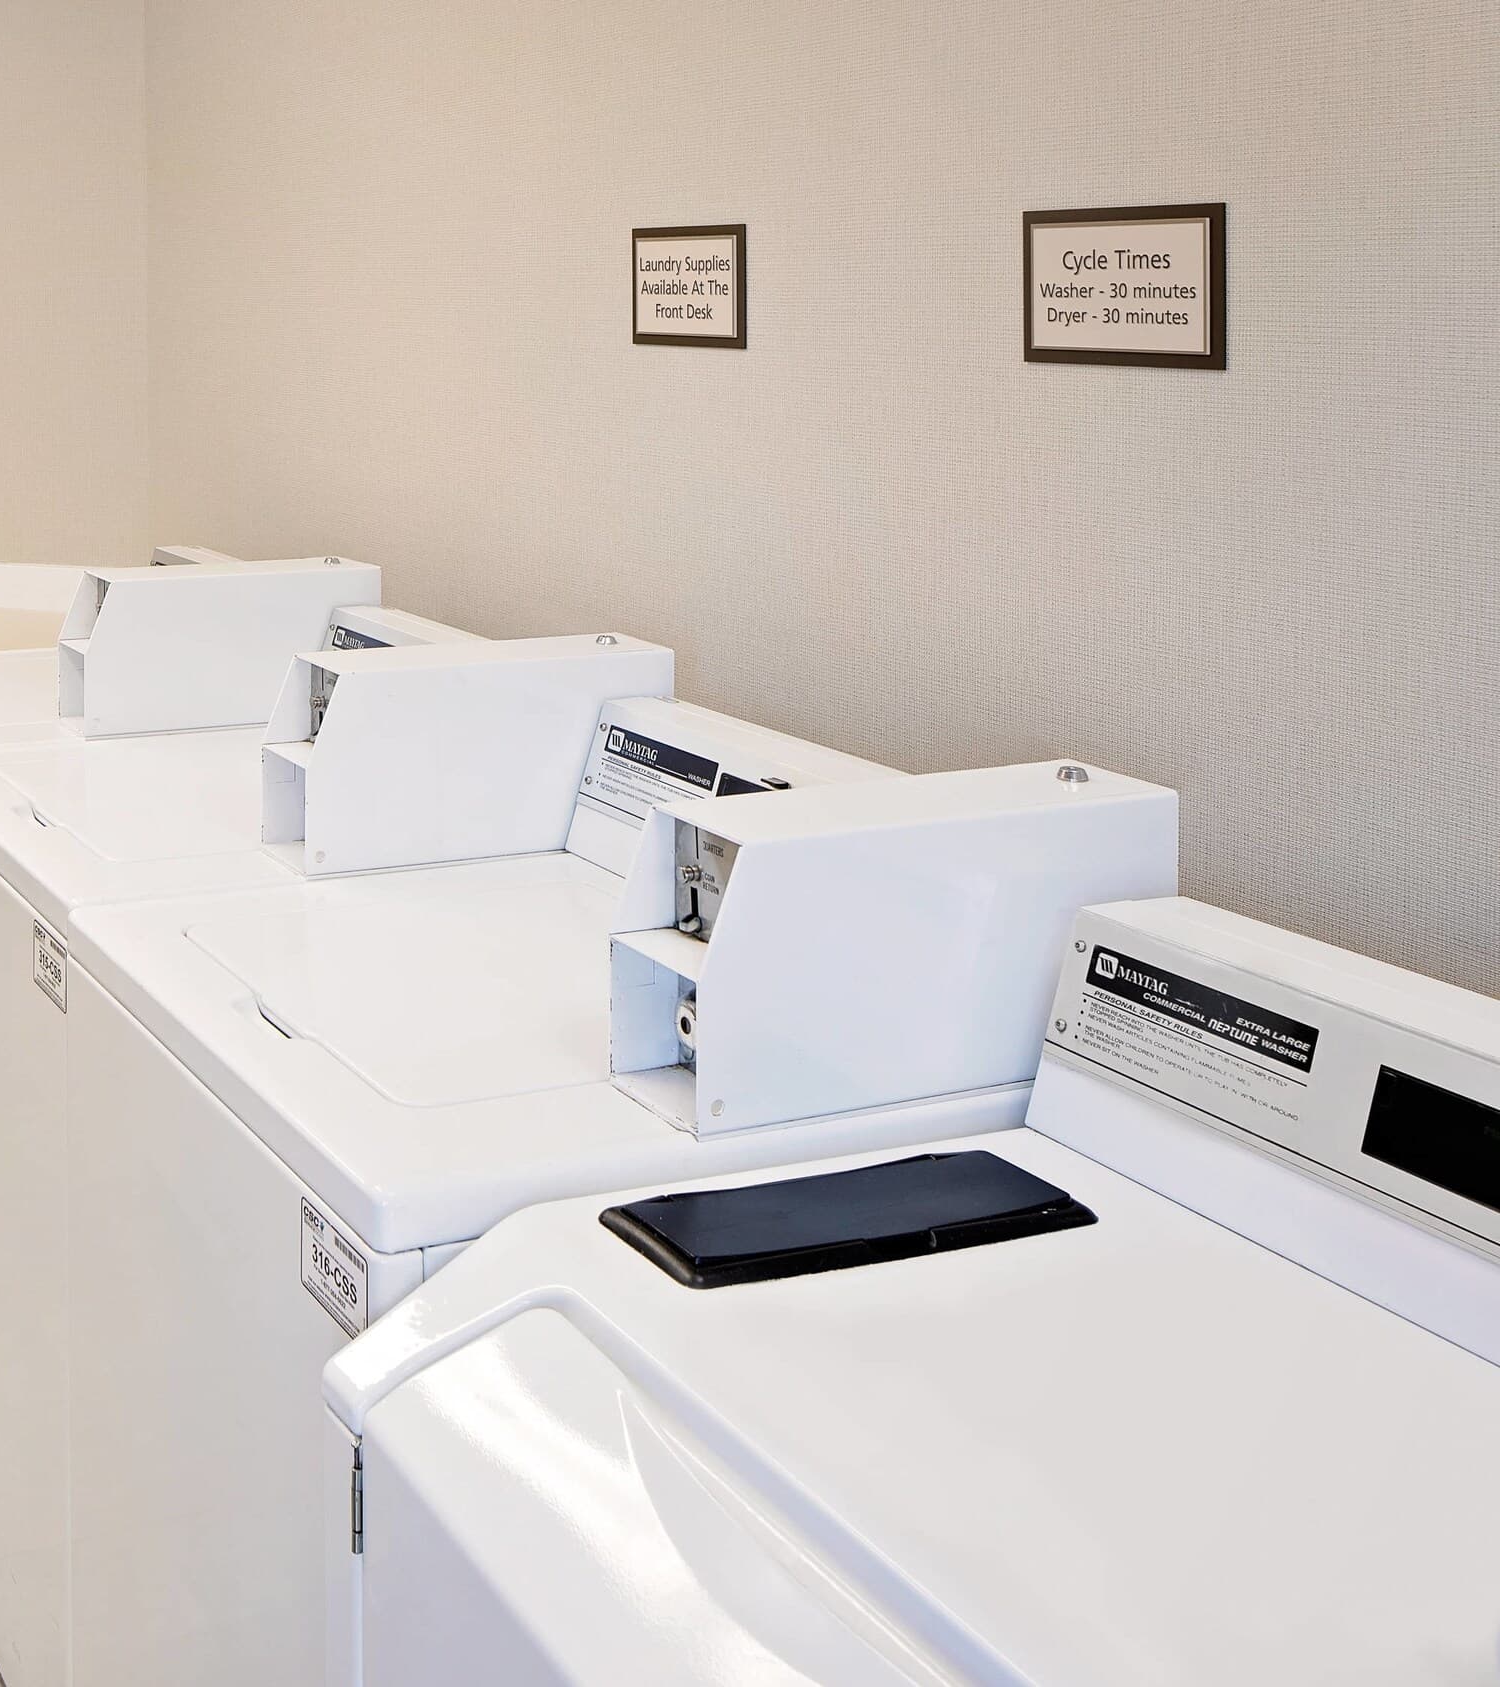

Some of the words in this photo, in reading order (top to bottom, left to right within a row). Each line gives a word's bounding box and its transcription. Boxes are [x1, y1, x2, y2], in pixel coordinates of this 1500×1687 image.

[639, 255, 682, 276] Laundry
[685, 254, 730, 276] Supplies
[1062, 249, 1108, 275] Cycle
[1114, 249, 1171, 269] Times
[641, 279, 688, 295] Available
[691, 280, 705, 295] At
[707, 279, 729, 295] The
[1039, 282, 1095, 299] Washer
[1109, 282, 1128, 299] 30
[1133, 282, 1197, 299] minutes
[655, 303, 684, 319] Front
[686, 303, 713, 320] Desk
[1047, 307, 1087, 327] Dryer
[1102, 307, 1120, 324] 30
[1125, 307, 1189, 325] minutes
[622, 739, 659, 761] MAYTAG
[687, 772, 712, 787] WASHER
[1117, 965, 1169, 996] MAYTAG
[1087, 1013, 1107, 1025] NEVER
[1107, 1020, 1125, 1032] WASH
[1091, 1001, 1110, 1013] NEVER
[1110, 1008, 1131, 1020] REACH
[1146, 1024, 1157, 1034] THE
[1094, 990, 1138, 1012] PERSONAL
[1139, 1008, 1172, 1026] SAFETY
[1173, 1023, 1204, 1040] RULES
[1142, 992, 1206, 1023] COMMERCIAL
[1207, 1018, 1260, 1047] NEPTUNE
[1261, 1039, 1308, 1063] WASHER
[1235, 1017, 1271, 1036] EXTRA
[1271, 1031, 1312, 1052] LARGE
[1082, 1037, 1101, 1049] NEVER
[1101, 1046, 1112, 1054] SIT
[1084, 1025, 1104, 1037] NEVER
[1104, 1033, 1124, 1045] ALLOW
[1125, 1042, 1155, 1058] CHILDREN
[1155, 1055, 1164, 1063] TO
[303, 1205, 320, 1228] CSC
[311, 1243, 358, 1305] 316-CSS
